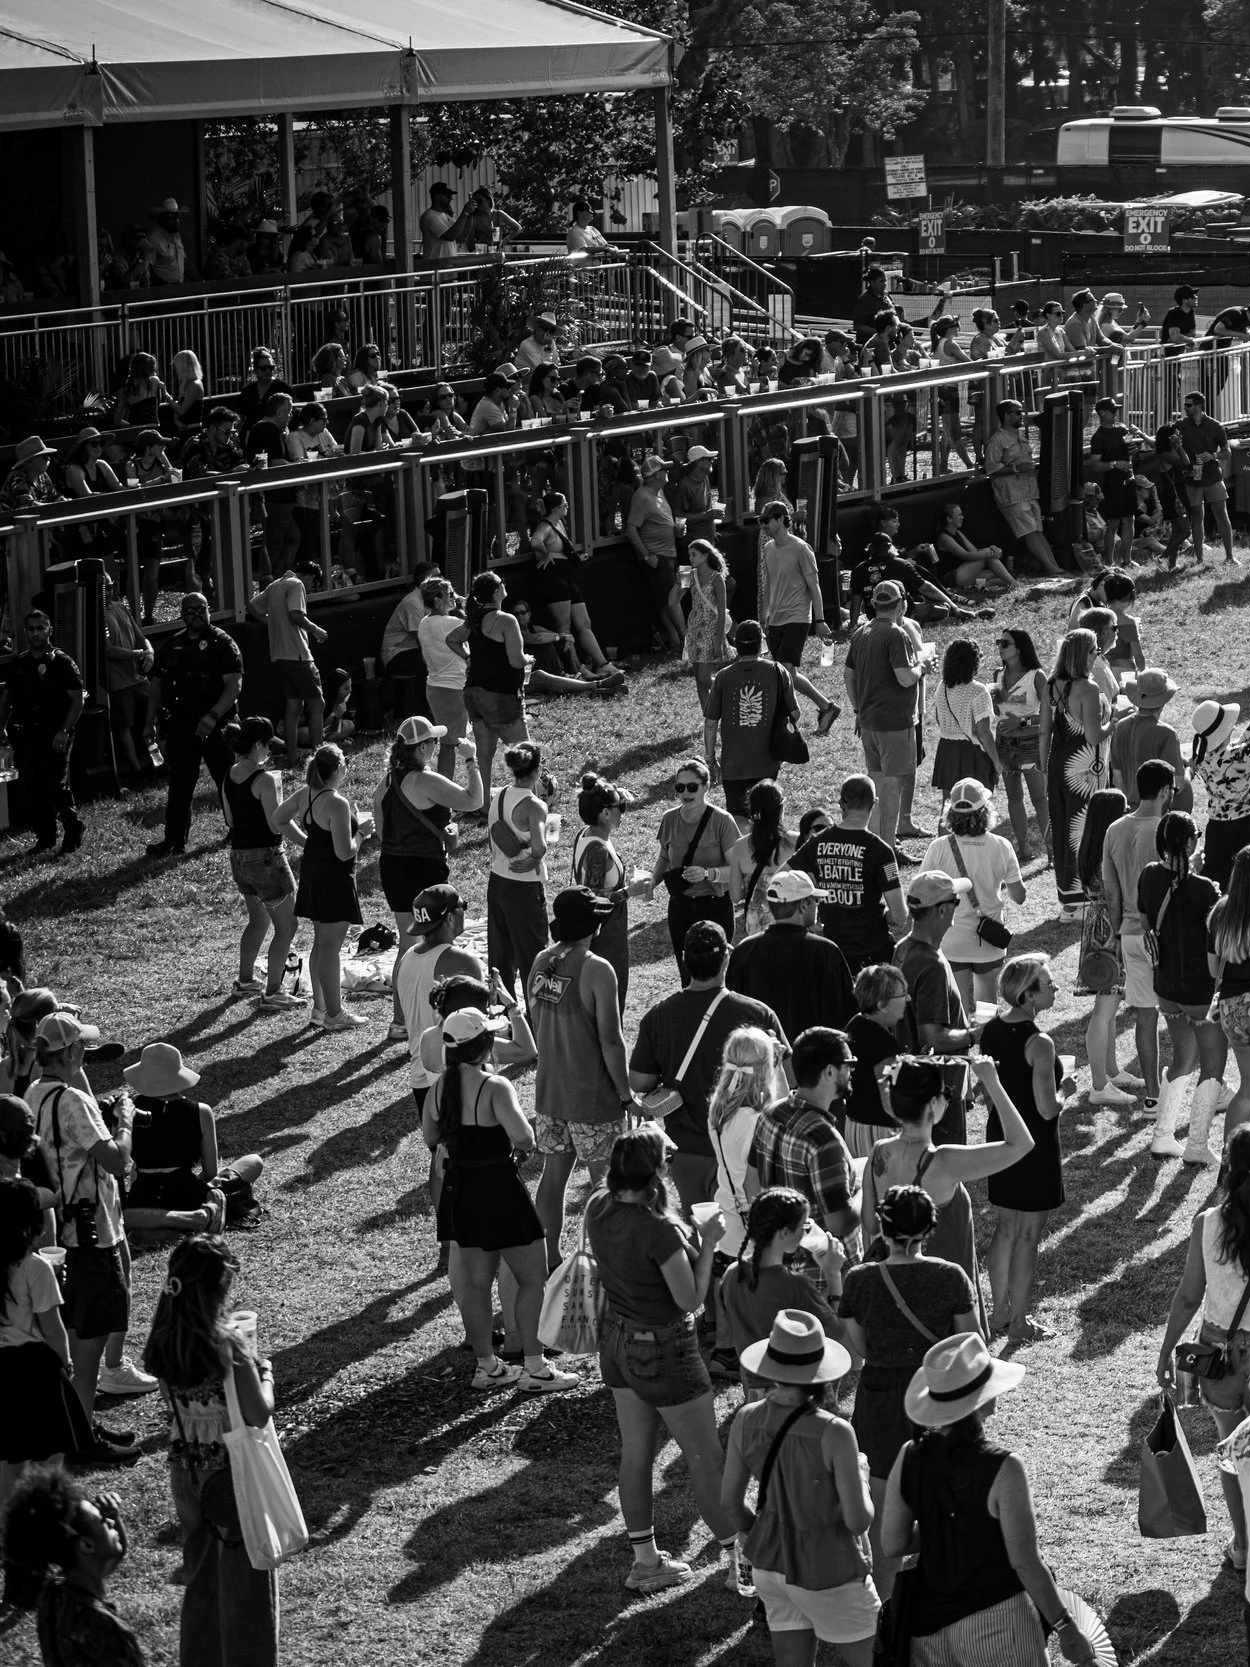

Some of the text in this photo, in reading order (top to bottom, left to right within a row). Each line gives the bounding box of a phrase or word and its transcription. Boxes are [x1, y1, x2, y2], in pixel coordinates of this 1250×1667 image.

[1126, 209, 1168, 217] EMERGENCY
[921, 219, 942, 237] EXIT
[1128, 216, 1165, 233] EXIT
[817, 842, 866, 859] EVERYONE
[824, 865, 863, 882] BATTLE
[561, 1314, 599, 1327] FRANC
